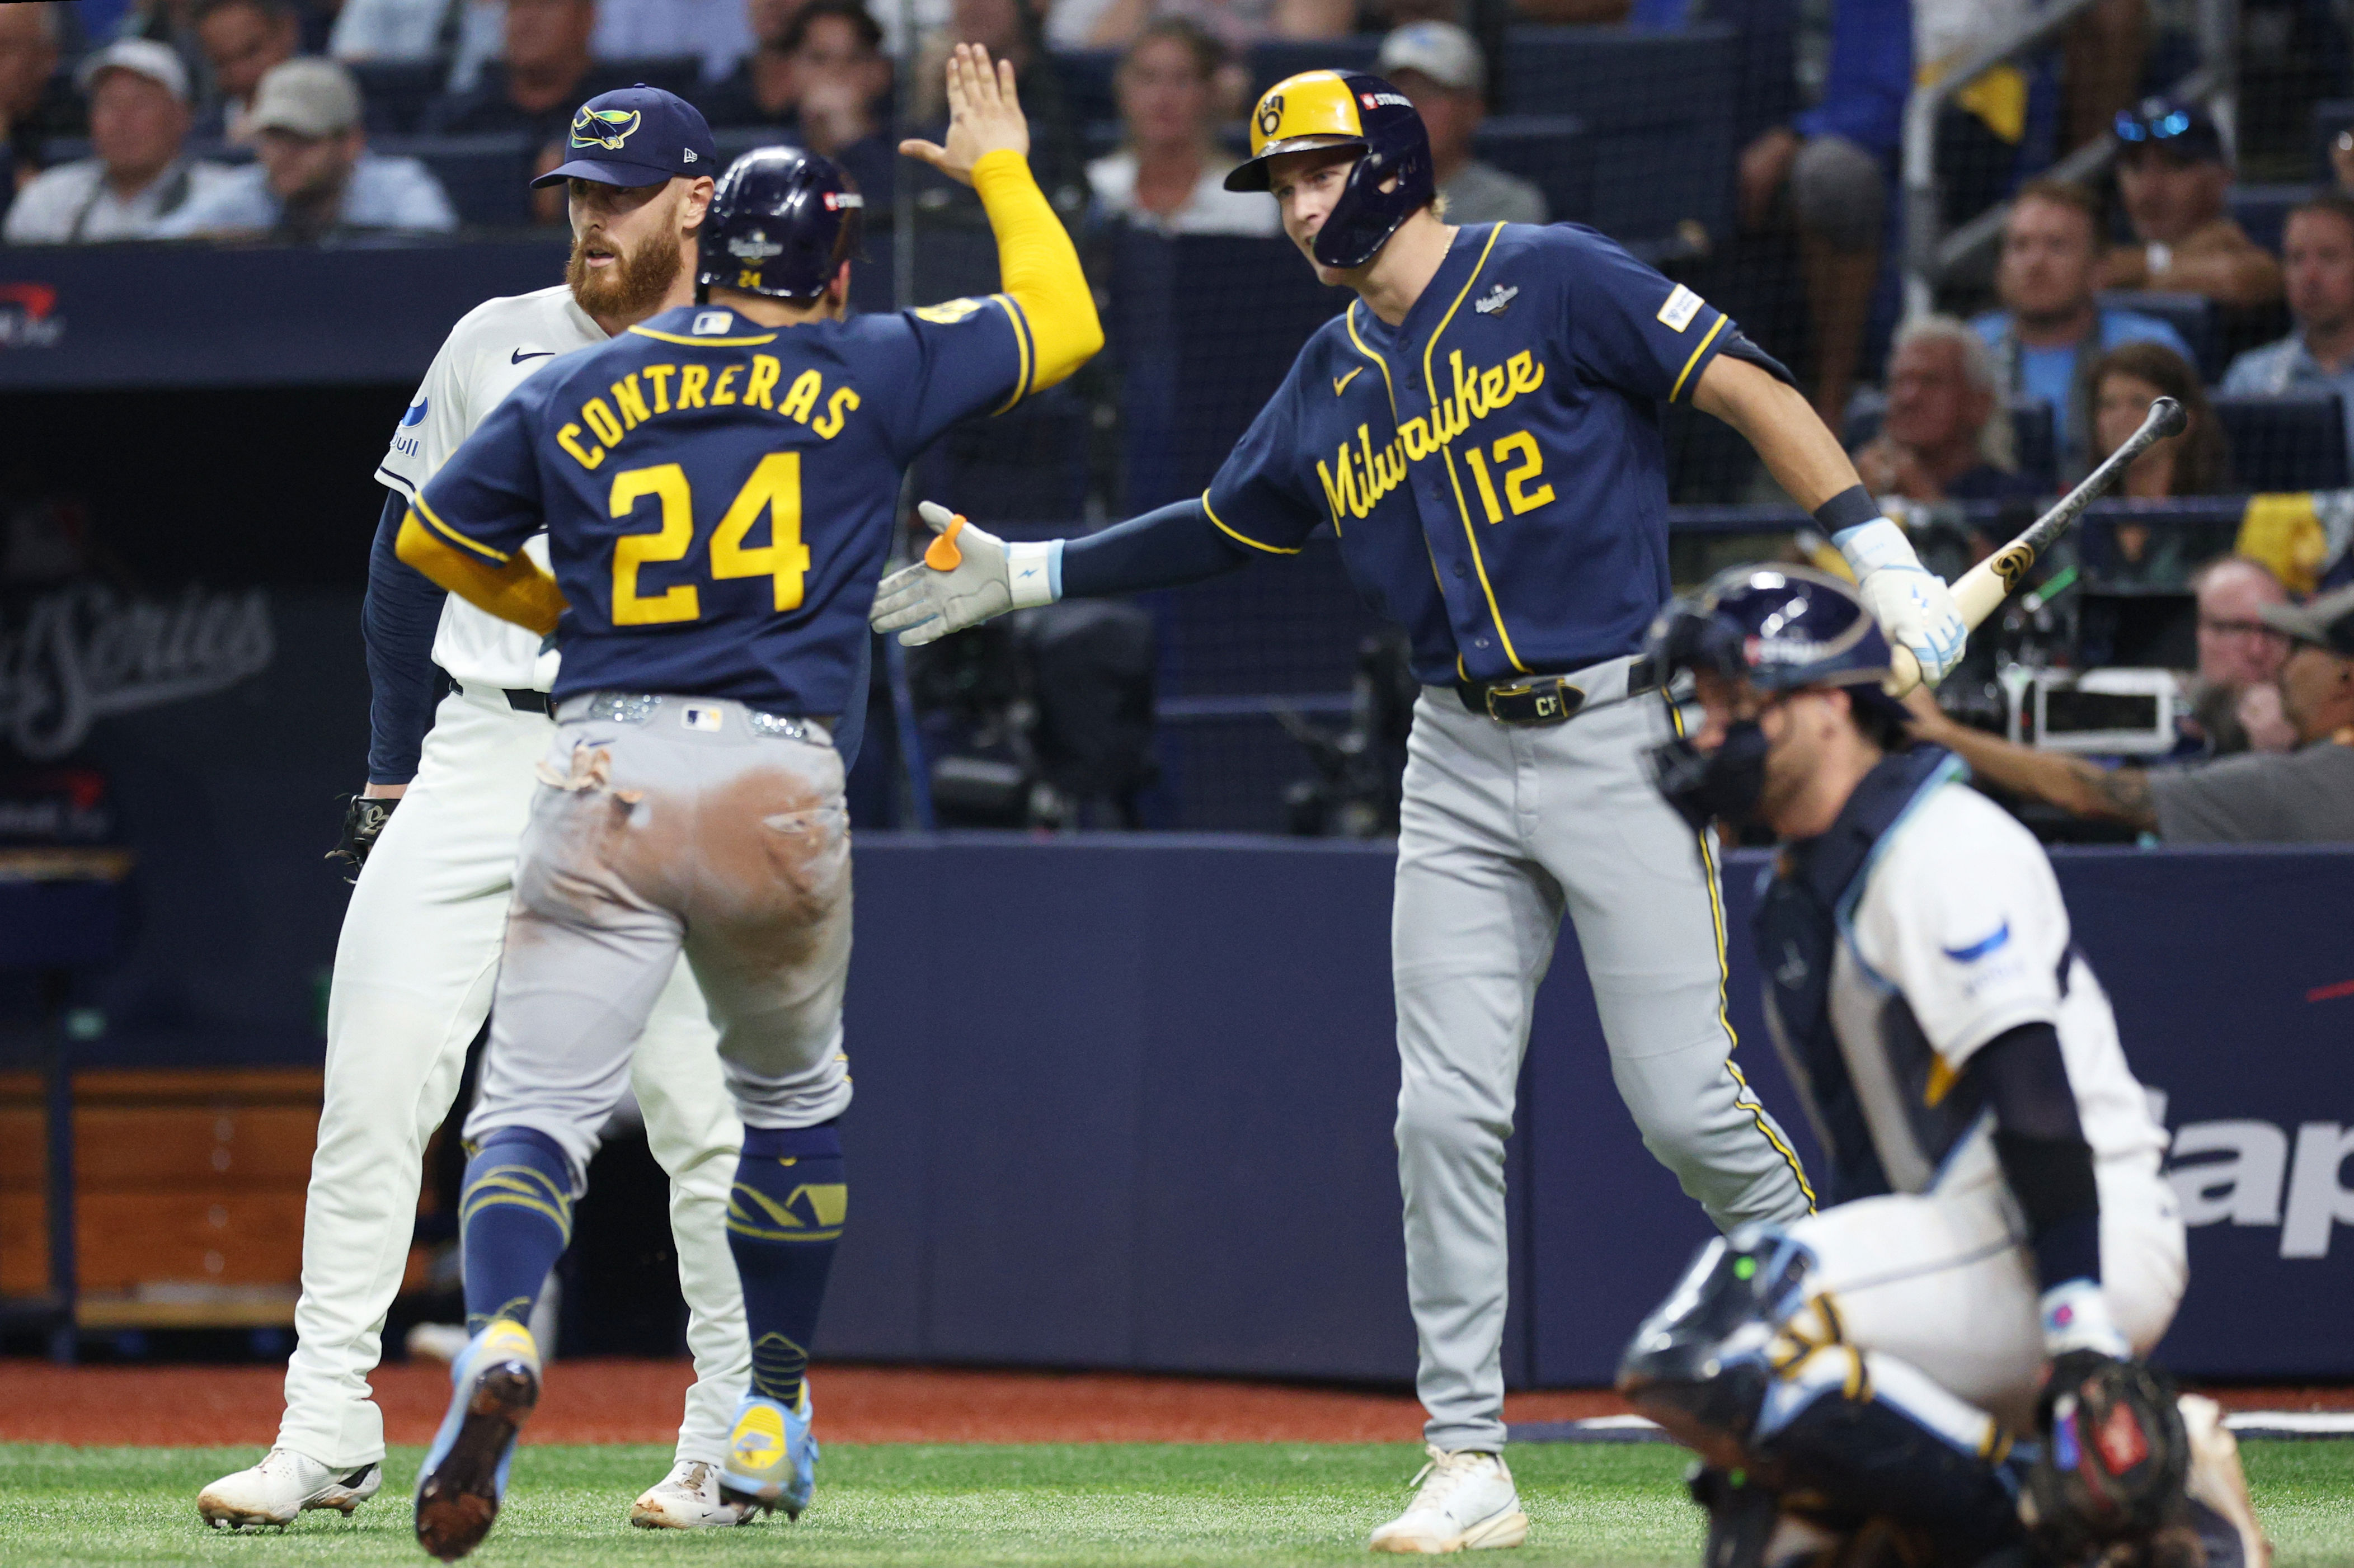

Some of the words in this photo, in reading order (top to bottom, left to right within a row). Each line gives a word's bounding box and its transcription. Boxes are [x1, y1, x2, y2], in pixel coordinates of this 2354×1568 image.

[556, 354, 861, 470] CONTRERAS
[1316, 349, 1545, 537] Milwaukee
[1464, 429, 1556, 525] 12
[609, 451, 811, 626] 24
[2146, 1085, 2354, 1259] ap
